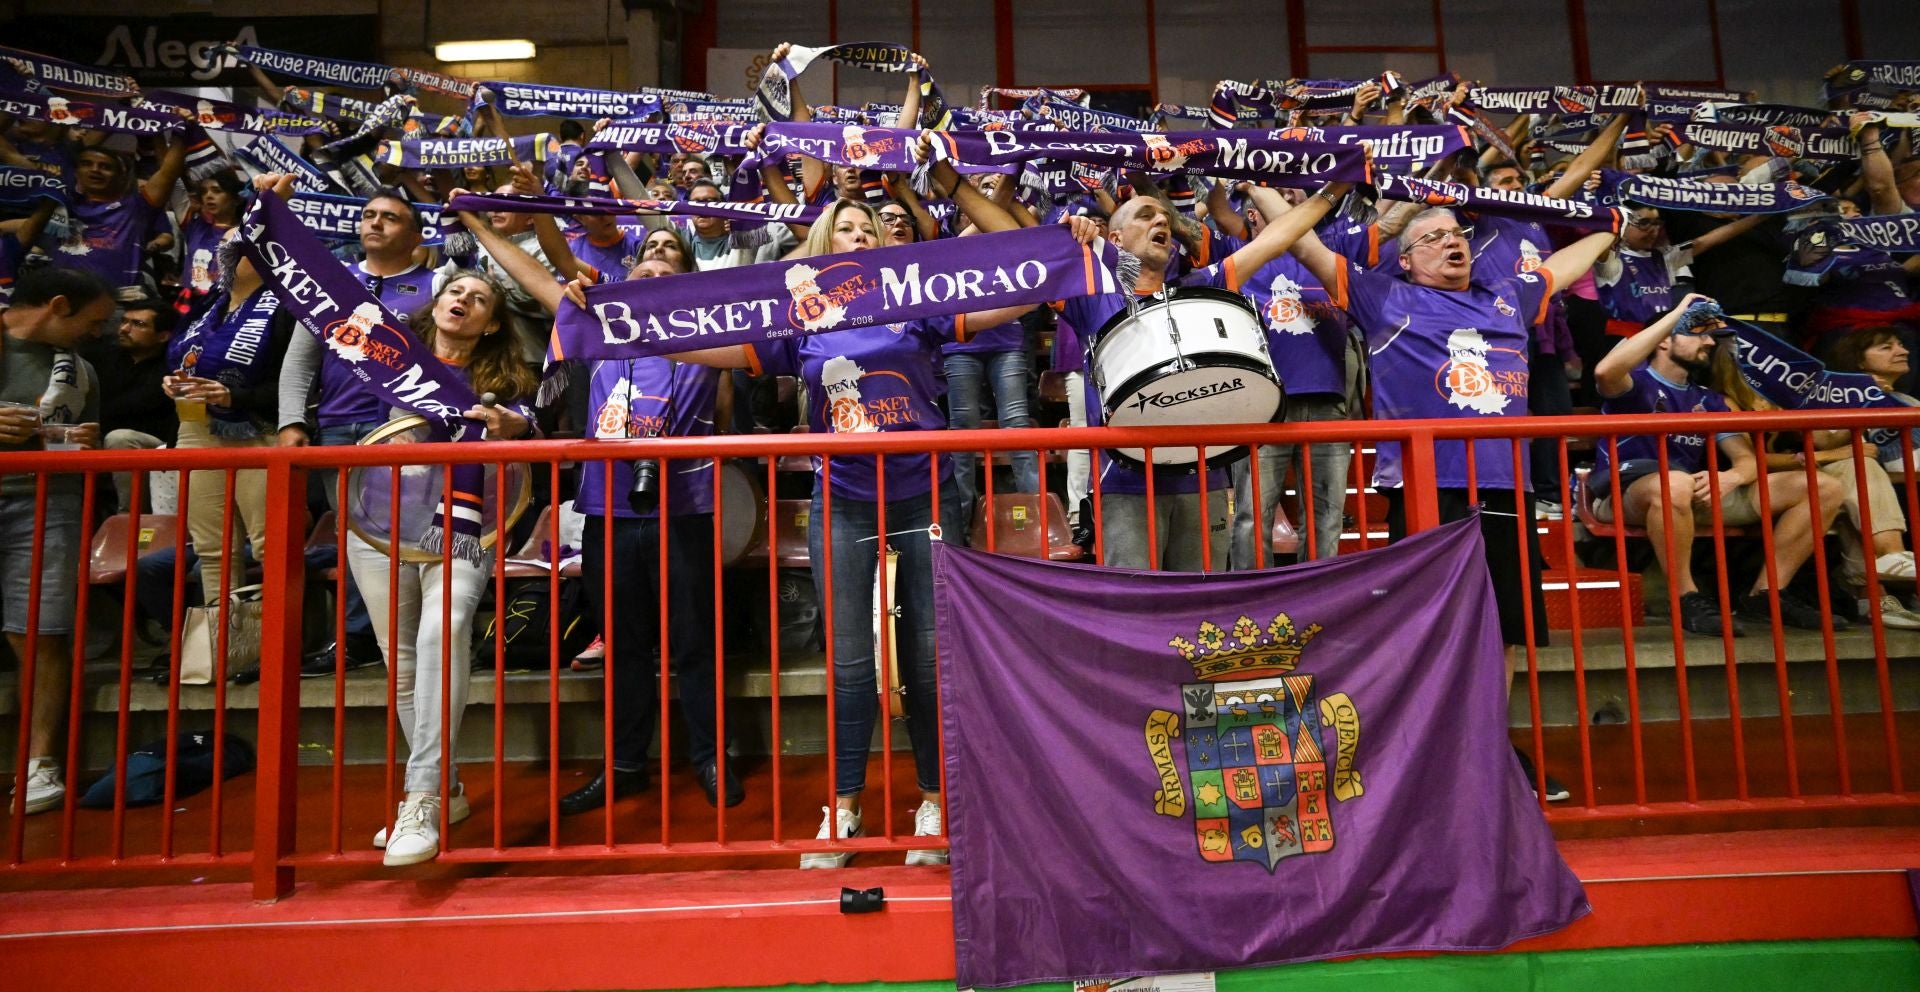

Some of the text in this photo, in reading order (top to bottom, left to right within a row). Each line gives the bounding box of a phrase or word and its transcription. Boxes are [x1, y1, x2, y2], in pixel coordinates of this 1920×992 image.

[503, 87, 657, 105] SENTIMIENTO
[505, 99, 634, 115] PALENTINO.
[594, 262, 1048, 345] BASKET MORAO
[766, 315, 874, 339] desde 2008
[302, 316, 371, 384] desde 2008
[827, 379, 857, 395] PEÑA
[1138, 377, 1244, 407] ROCKSTAR
[1335, 704, 1355, 789] CIENCIA
